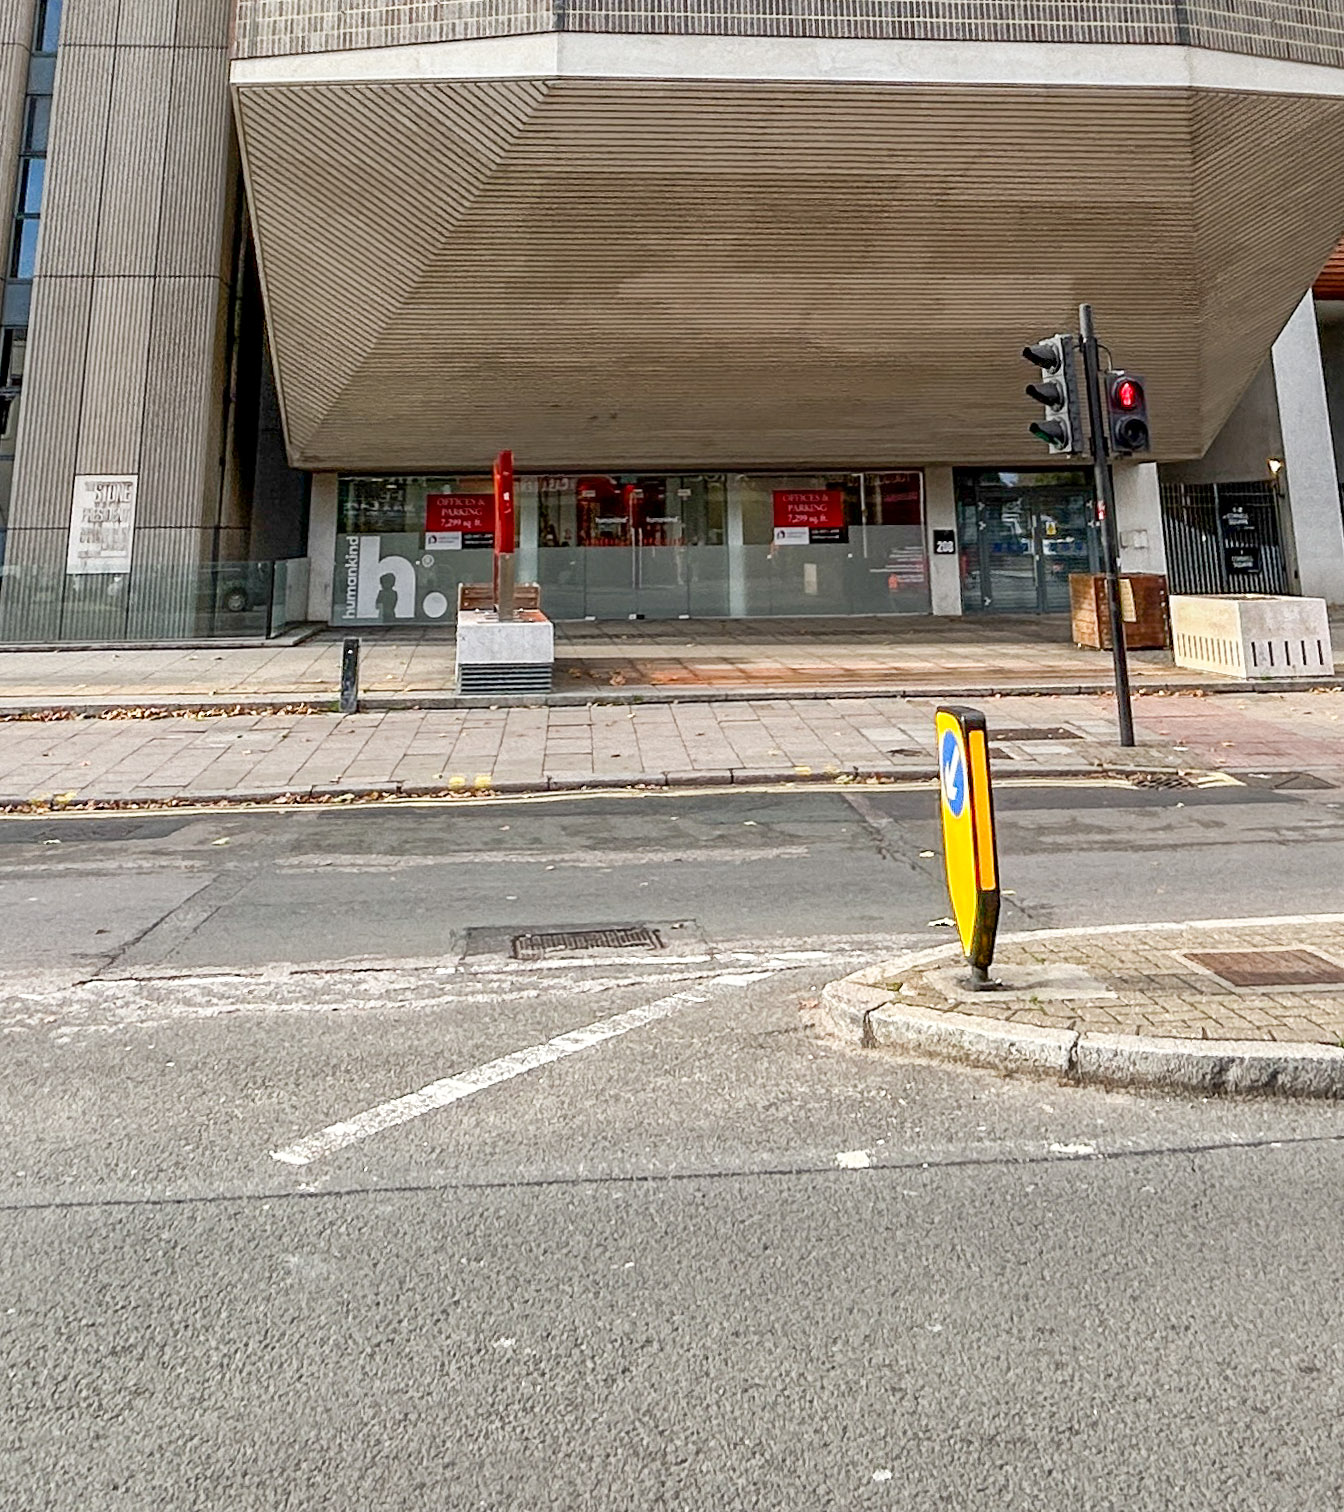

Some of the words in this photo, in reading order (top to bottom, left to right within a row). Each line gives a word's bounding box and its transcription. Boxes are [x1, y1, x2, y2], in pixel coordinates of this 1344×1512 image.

[94, 482, 133, 502] STONE
[436, 497, 476, 506] OFFICES
[441, 508, 483, 516] PARKING
[787, 504, 828, 512] PARKING
[342, 536, 359, 620] humankind
